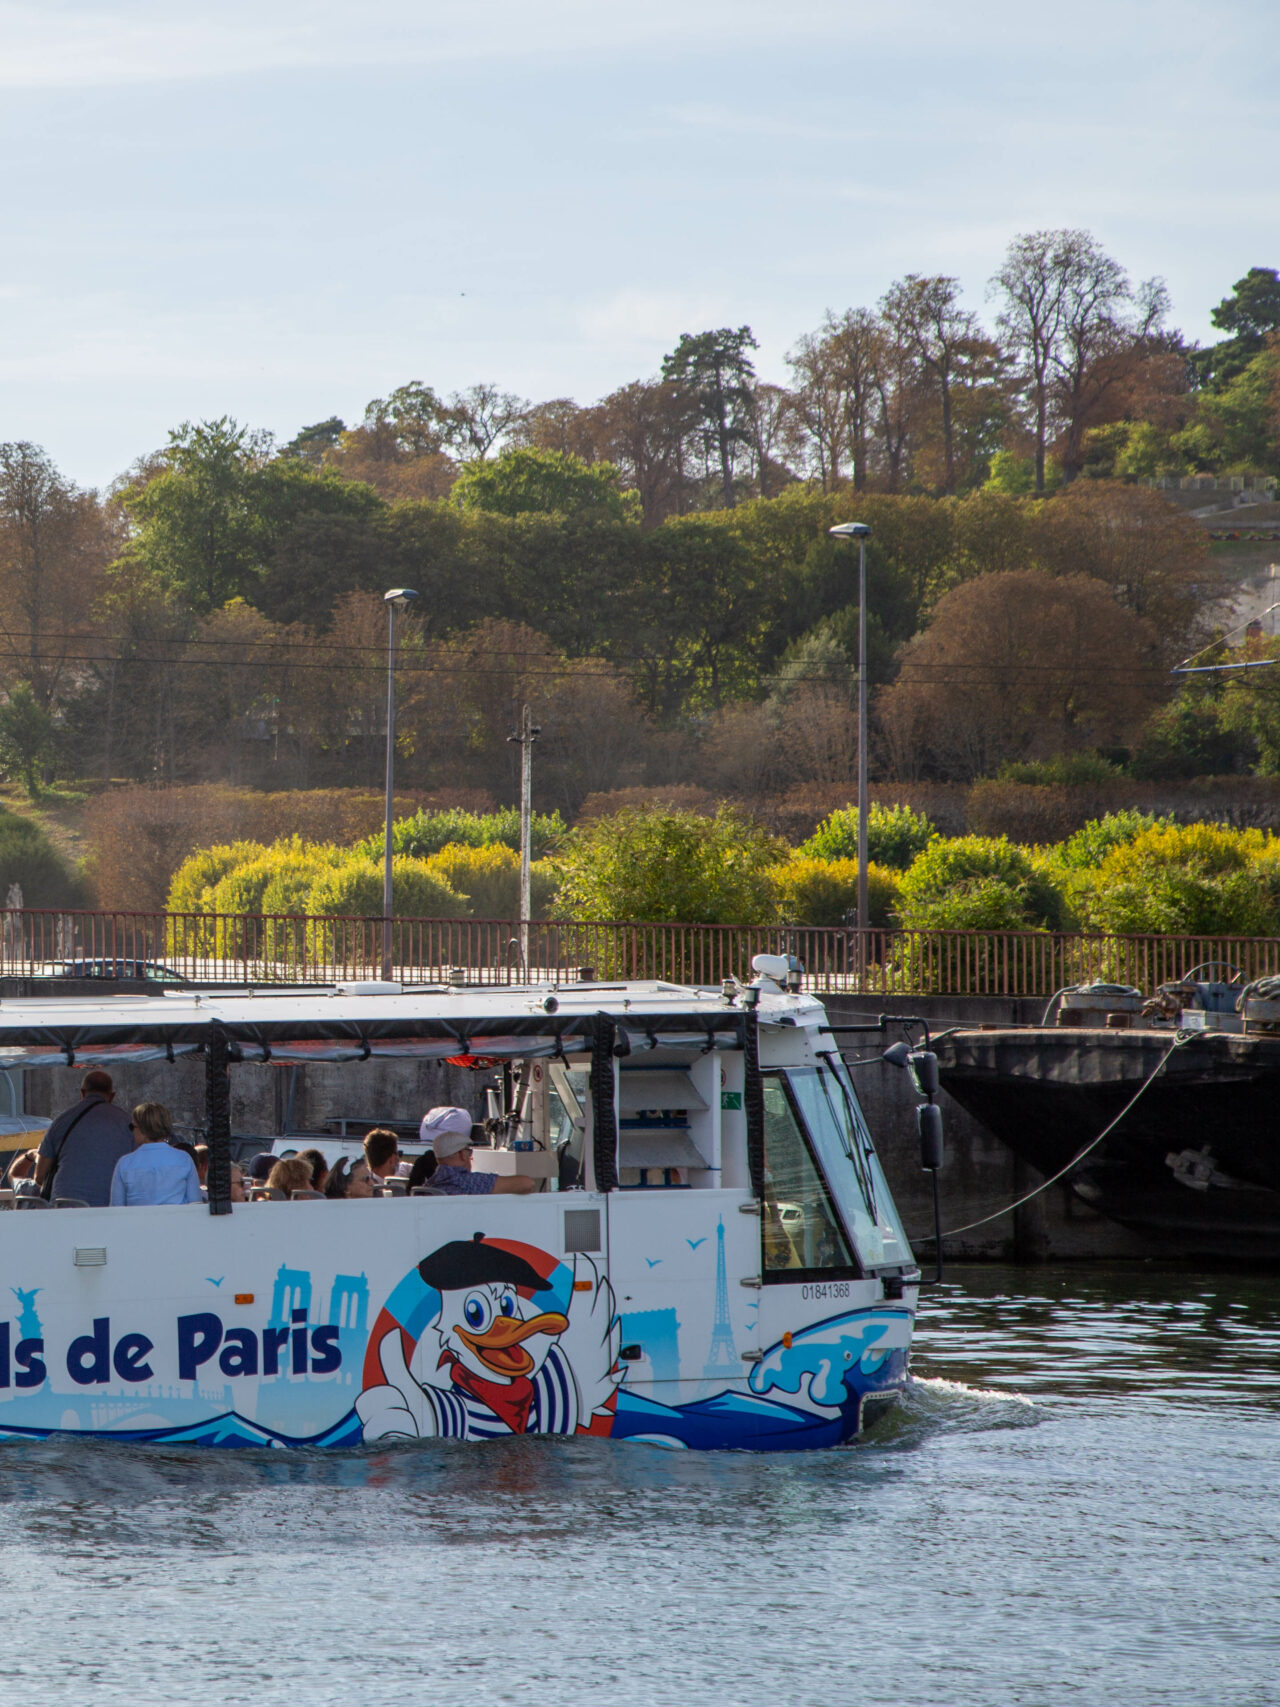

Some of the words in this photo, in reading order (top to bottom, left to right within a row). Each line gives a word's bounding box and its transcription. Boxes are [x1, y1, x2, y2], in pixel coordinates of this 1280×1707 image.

[802, 1283, 850, 1300] 01841368
[66, 1316, 154, 1385] de
[177, 1308, 343, 1380] Paris
